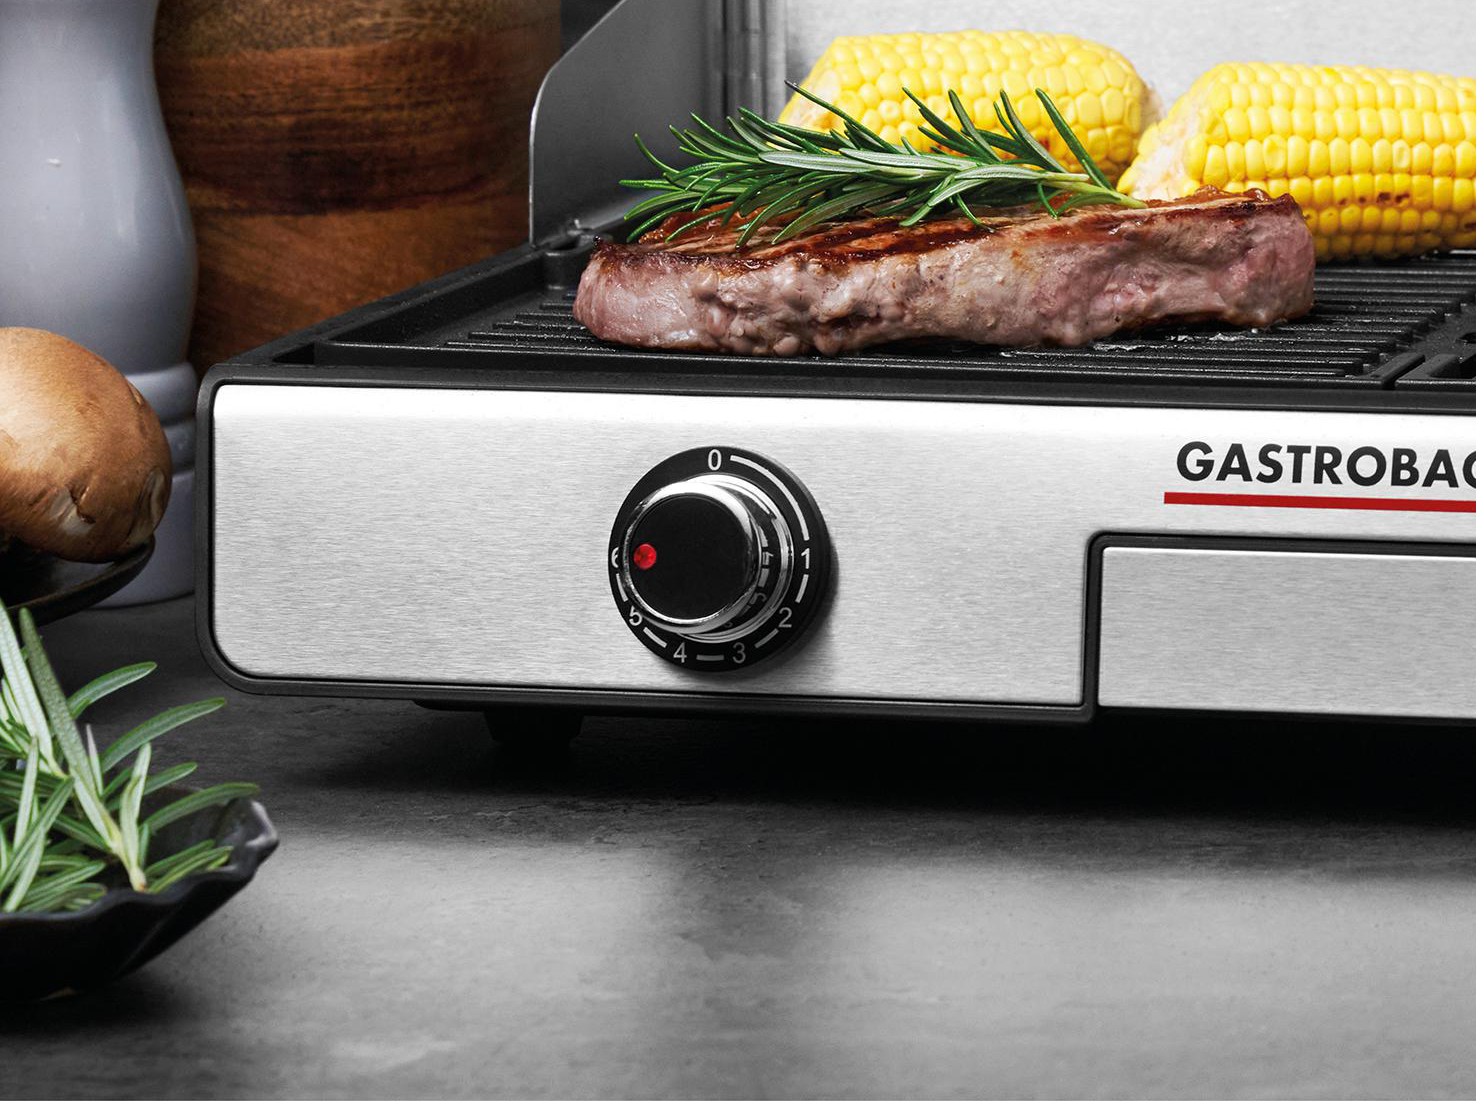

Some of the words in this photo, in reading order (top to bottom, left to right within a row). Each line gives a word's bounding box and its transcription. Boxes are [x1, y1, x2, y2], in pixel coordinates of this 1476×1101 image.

[707, 449, 722, 471] 0
[800, 548, 811, 570] 1
[629, 606, 643, 627] 5
[778, 607, 792, 628] 2
[673, 642, 687, 663] 4
[732, 642, 746, 663] 3
